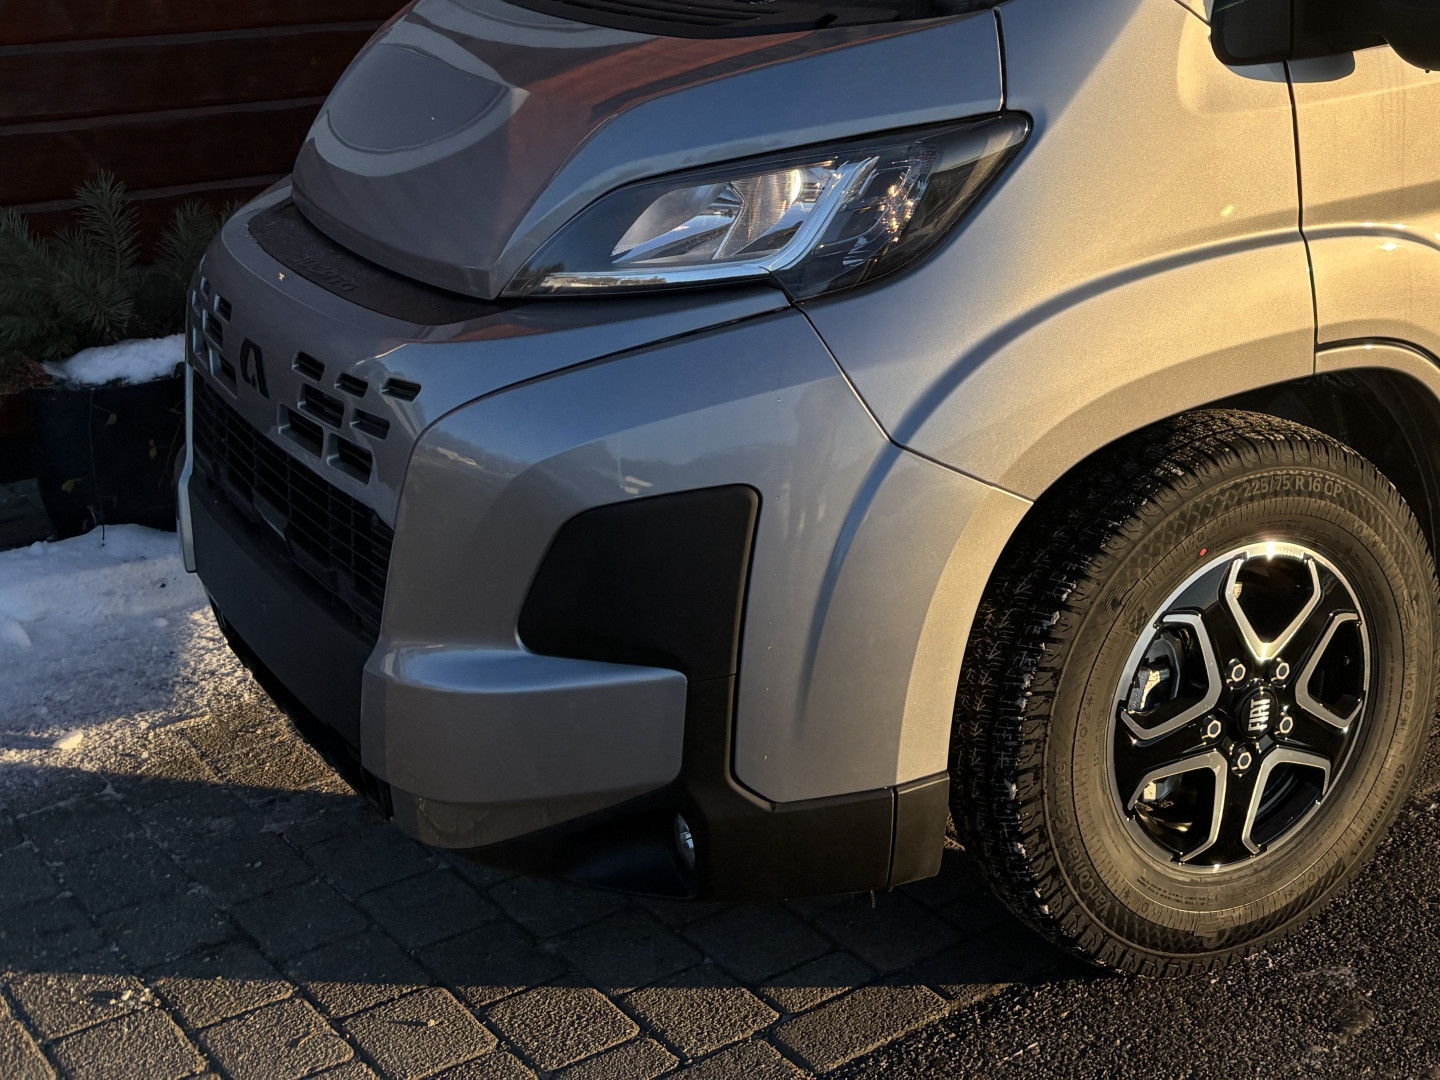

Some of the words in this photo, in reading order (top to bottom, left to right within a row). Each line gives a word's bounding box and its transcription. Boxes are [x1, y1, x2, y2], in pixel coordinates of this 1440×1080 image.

[1243, 475, 1291, 497] 225/75
[1295, 475, 1305, 490] R
[1307, 476, 1321, 492] 16
[1248, 698, 1271, 731] FIAT
